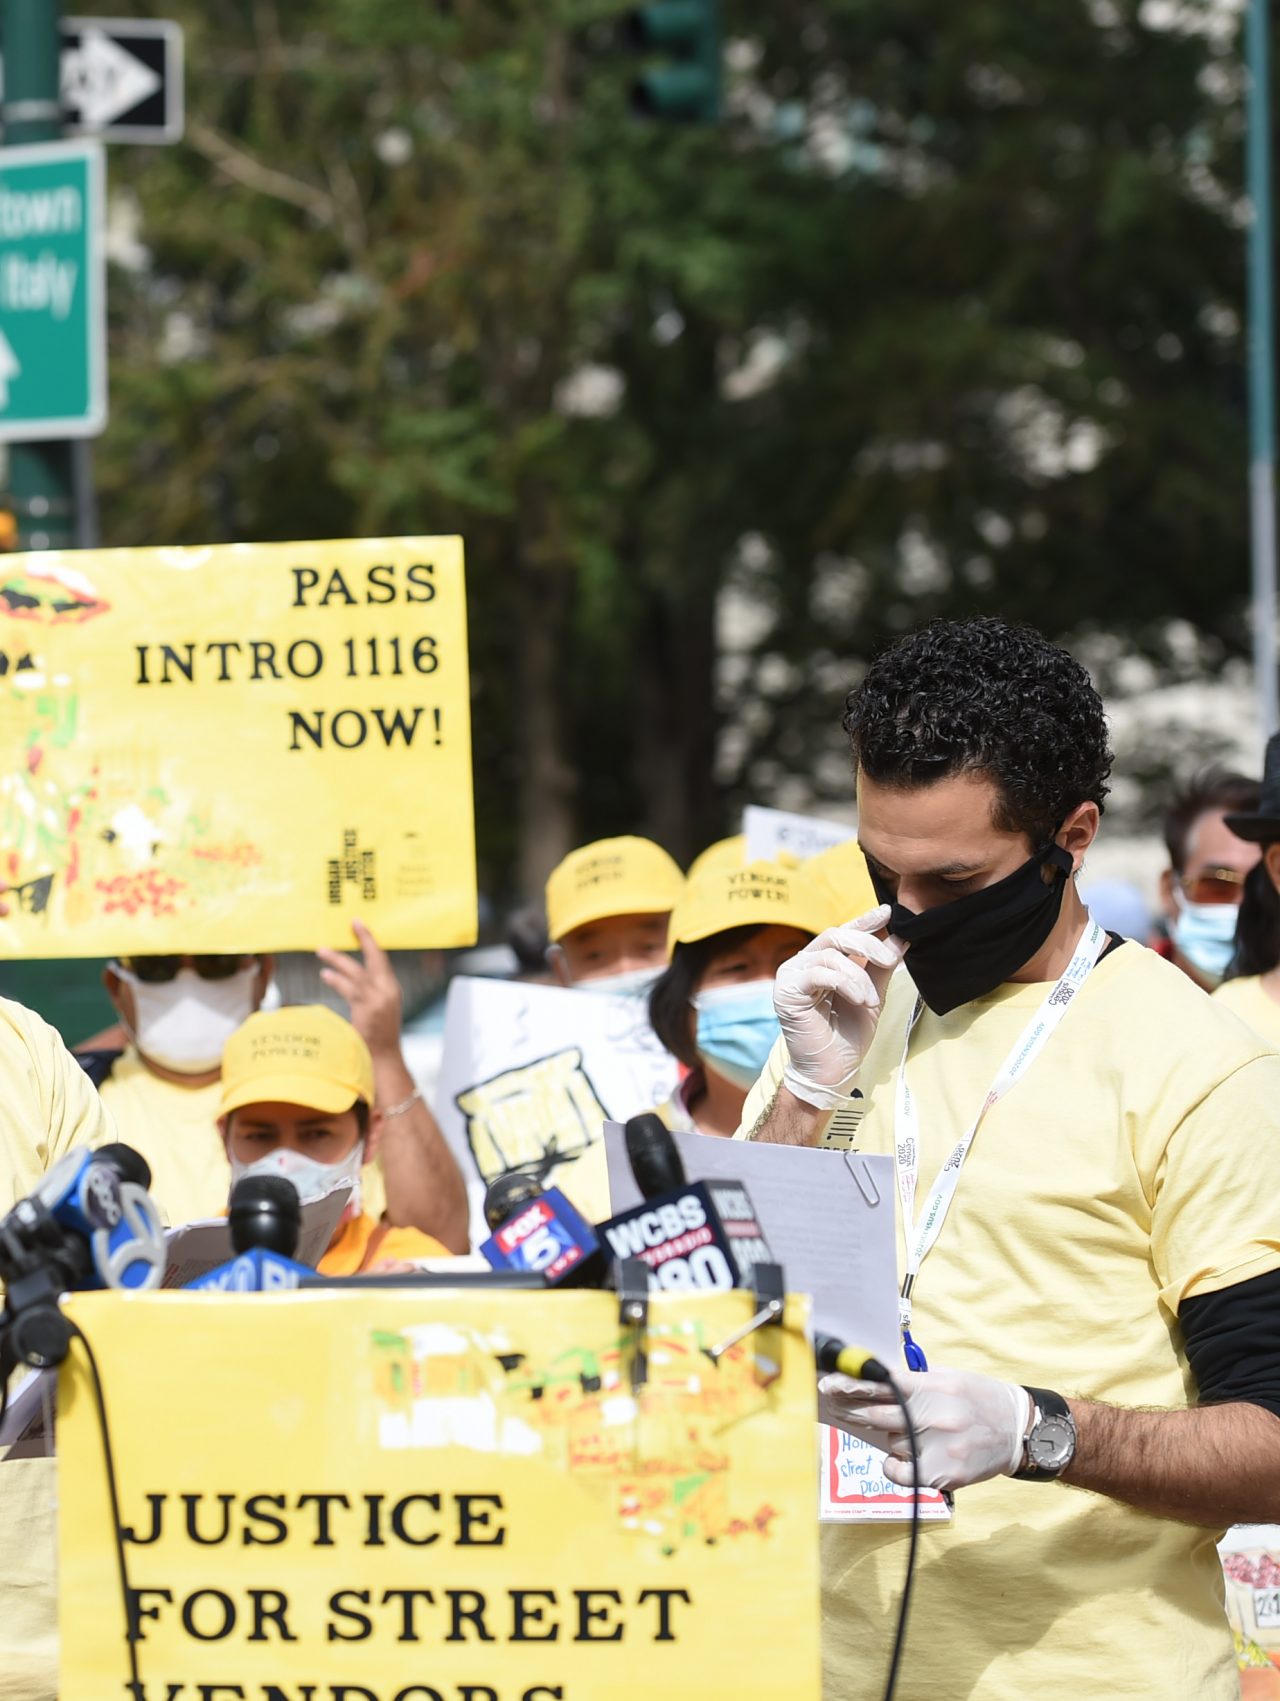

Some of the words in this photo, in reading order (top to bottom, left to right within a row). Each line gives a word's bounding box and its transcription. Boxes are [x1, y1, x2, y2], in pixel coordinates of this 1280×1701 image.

[2, 251, 78, 320] Italy
[292, 564, 437, 608] PASS
[135, 639, 324, 685] INTRO
[344, 636, 440, 677] 1116
[288, 707, 444, 752] NOW!
[1060, 988, 1075, 1006] 2020
[898, 1144, 906, 1165] 2020
[500, 1204, 548, 1249] FOX
[521, 1224, 562, 1272] 5
[605, 1194, 707, 1259] WCBS
[859, 1476, 904, 1500] projec
[122, 1493, 506, 1546] JUSTICE
[126, 1588, 298, 1642] FOR
[327, 1588, 692, 1642] STREET
